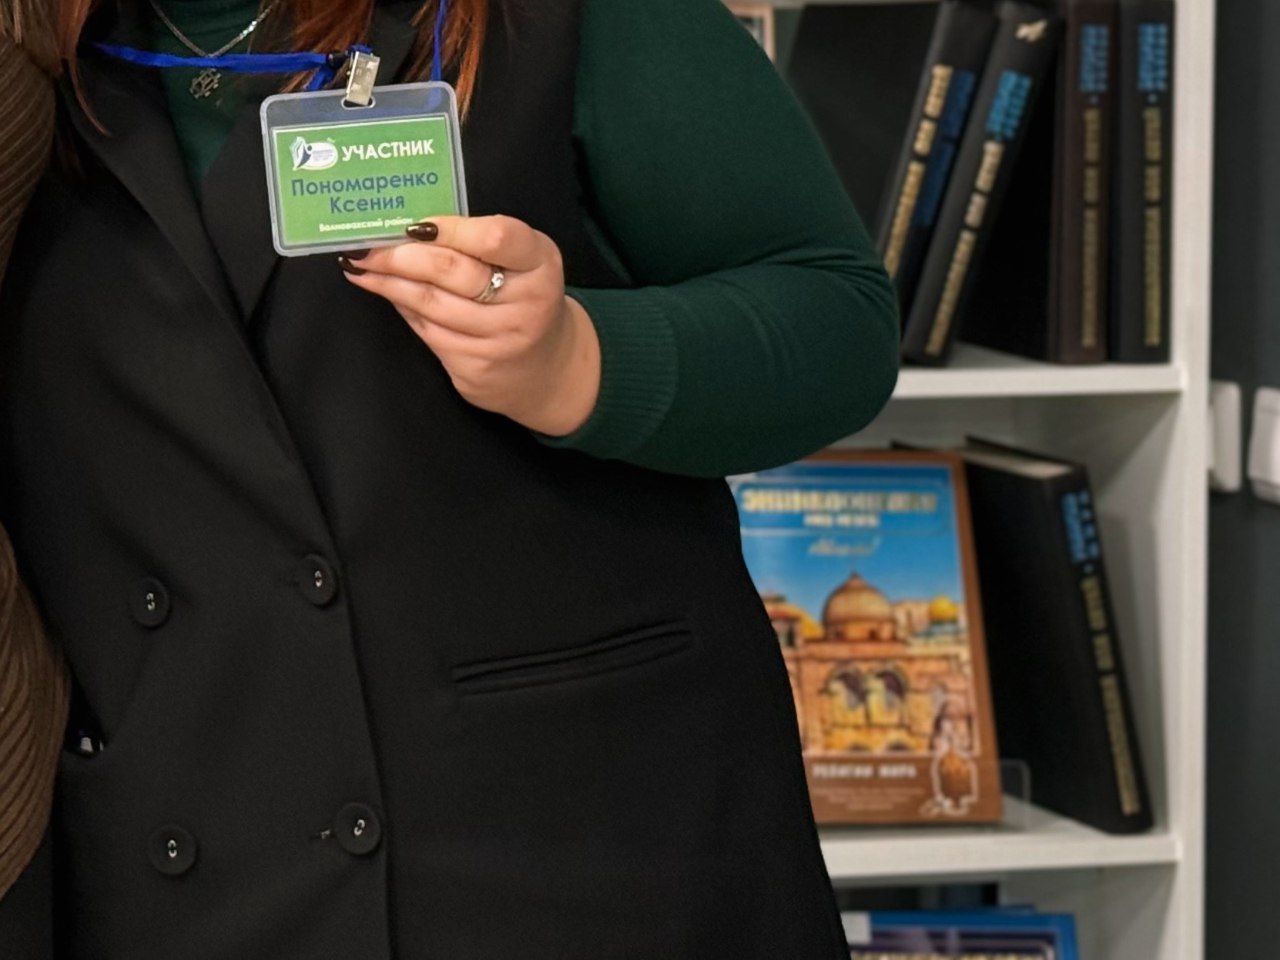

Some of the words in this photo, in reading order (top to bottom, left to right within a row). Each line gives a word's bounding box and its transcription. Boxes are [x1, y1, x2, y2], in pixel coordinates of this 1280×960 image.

[342, 139, 435, 161] УЧАСТНИК
[291, 171, 439, 196] Пономаренко
[330, 196, 405, 214] Ксения
[384, 216, 414, 228] район
